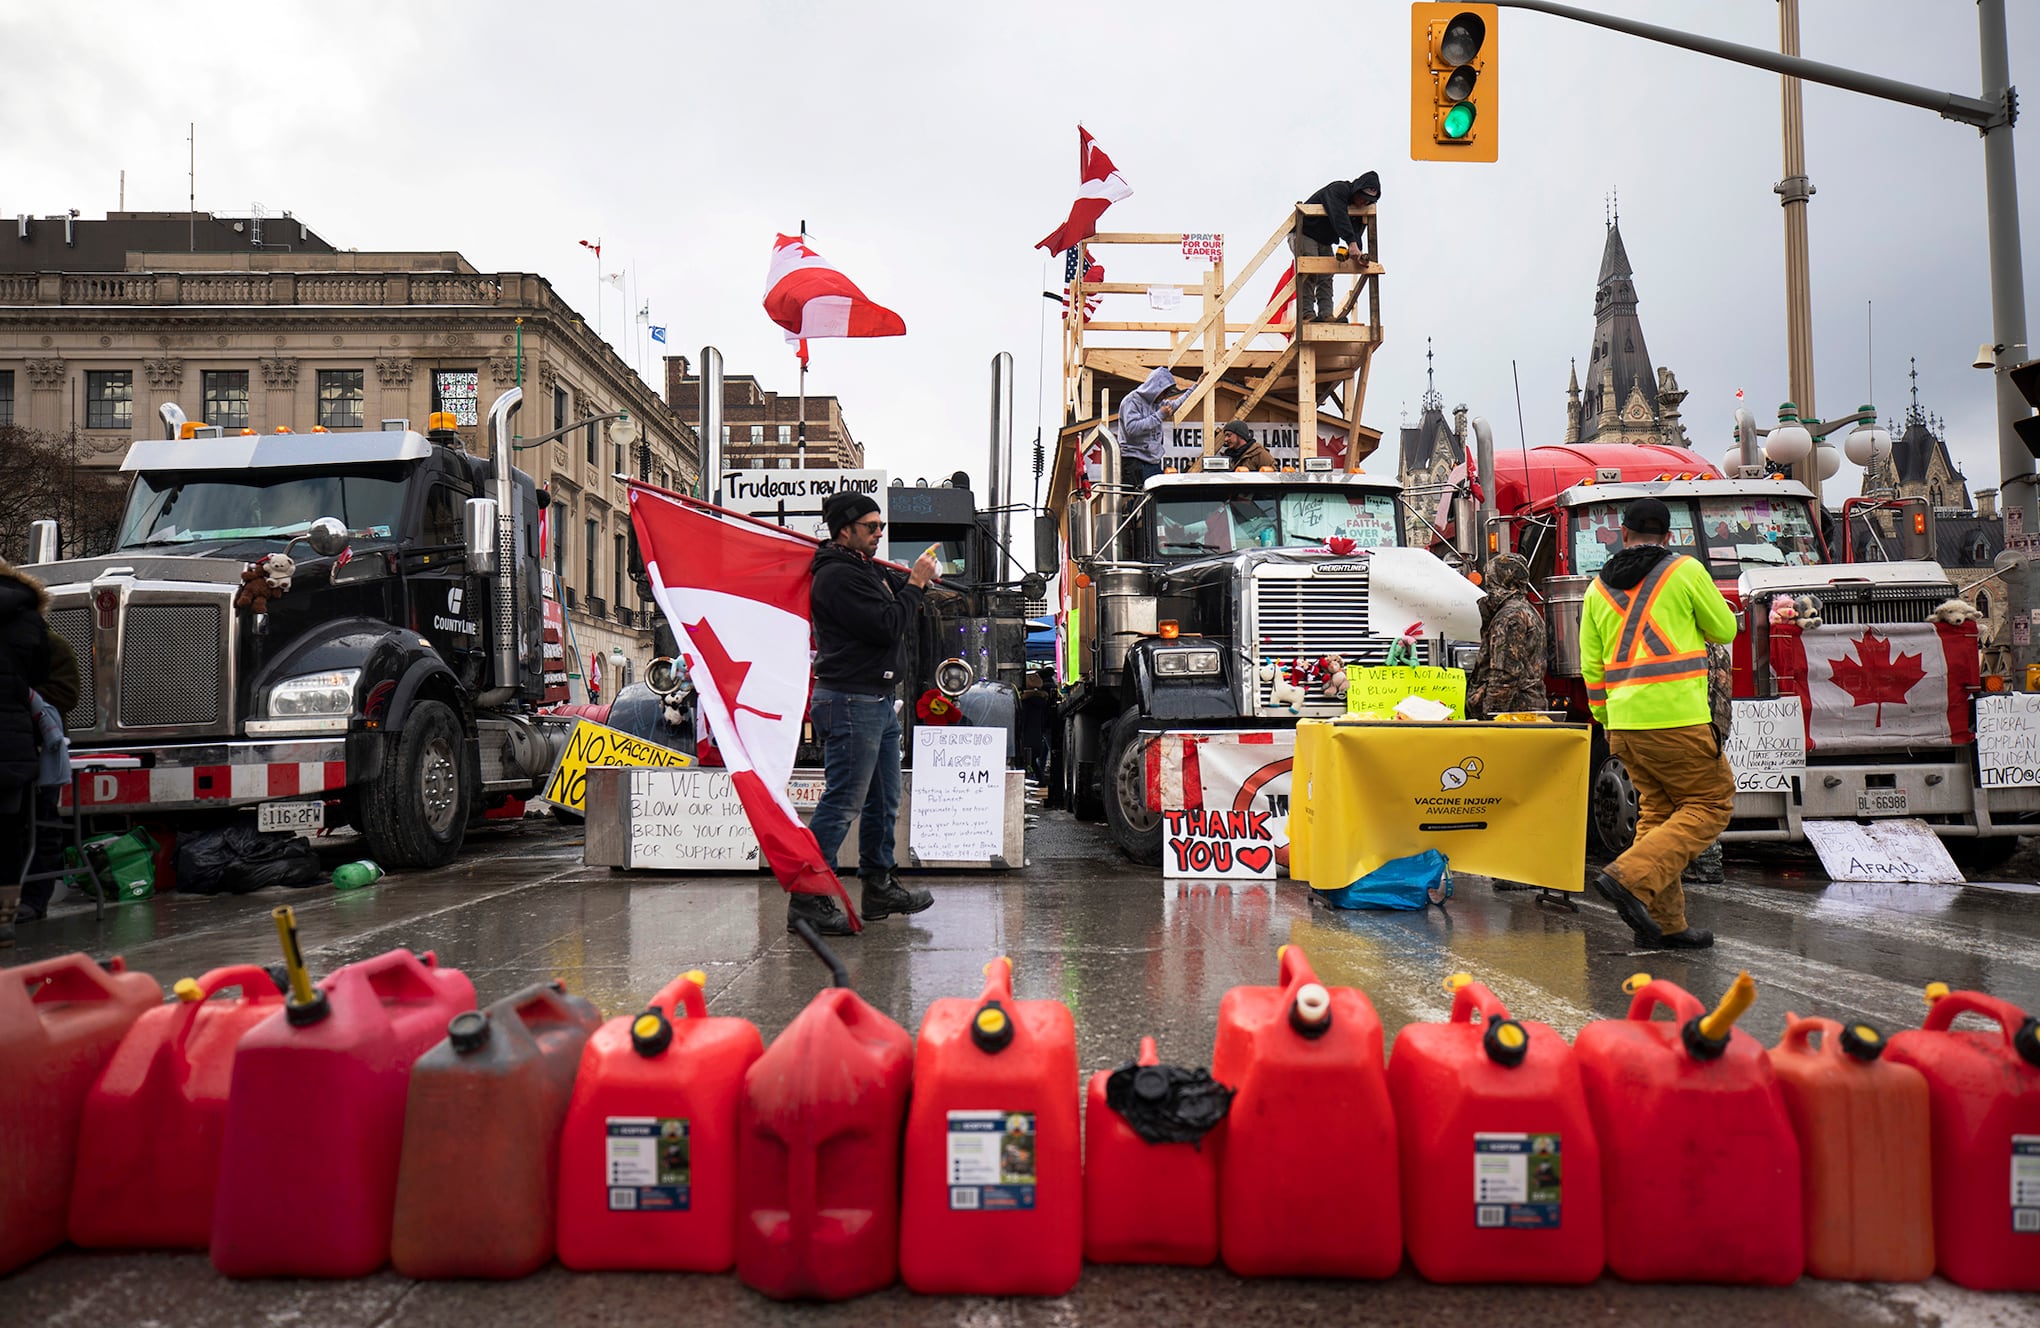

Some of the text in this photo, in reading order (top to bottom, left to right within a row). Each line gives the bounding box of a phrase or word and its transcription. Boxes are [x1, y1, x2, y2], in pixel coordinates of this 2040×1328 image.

[1182, 248, 1222, 256] LEADERS
[1173, 428, 1202, 448] KEE
[722, 472, 878, 499] Trudeau's new home
[1346, 519, 1380, 528] FAITH
[1350, 529, 1379, 538] OVER
[1358, 538, 1378, 547] EAR
[1319, 564, 1367, 573] FREIGHTLINER
[1348, 666, 1363, 682] IF
[1368, 668, 1405, 680] WE'RE
[1414, 670, 1432, 680] NOT
[1368, 686, 1398, 696] BLOW
[1407, 685, 1428, 694] THE
[1352, 700, 1385, 711] PLEASE
[1736, 701, 1800, 719] GOVERNOR
[1977, 696, 2020, 715] EMAIL
[1753, 720, 1775, 736] TO
[1978, 716, 2036, 734] GENERAL
[920, 728, 993, 747] JERICHO
[1756, 736, 1801, 751] ABOUT
[1978, 734, 2037, 752] COMPLAIN
[566, 728, 684, 767] NO VACCINE
[932, 748, 982, 768] MARCH
[1752, 752, 1770, 760] HATE
[631, 770, 658, 797] IF
[671, 772, 700, 799] WE
[958, 769, 989, 784] 9AM
[631, 800, 678, 819] BLOW
[688, 802, 713, 816] OUR
[1414, 797, 1502, 806] VACCINE INJURY
[1858, 796, 1907, 810] BL 66988
[268, 808, 321, 824] 116 2FW
[1426, 806, 1487, 815] AWARENESS
[633, 824, 683, 838] BRING
[1164, 810, 1273, 842] THANK
[634, 844, 664, 859] FOR
[1168, 837, 1234, 872] YOU
[1850, 856, 1924, 874] AFRAID.
